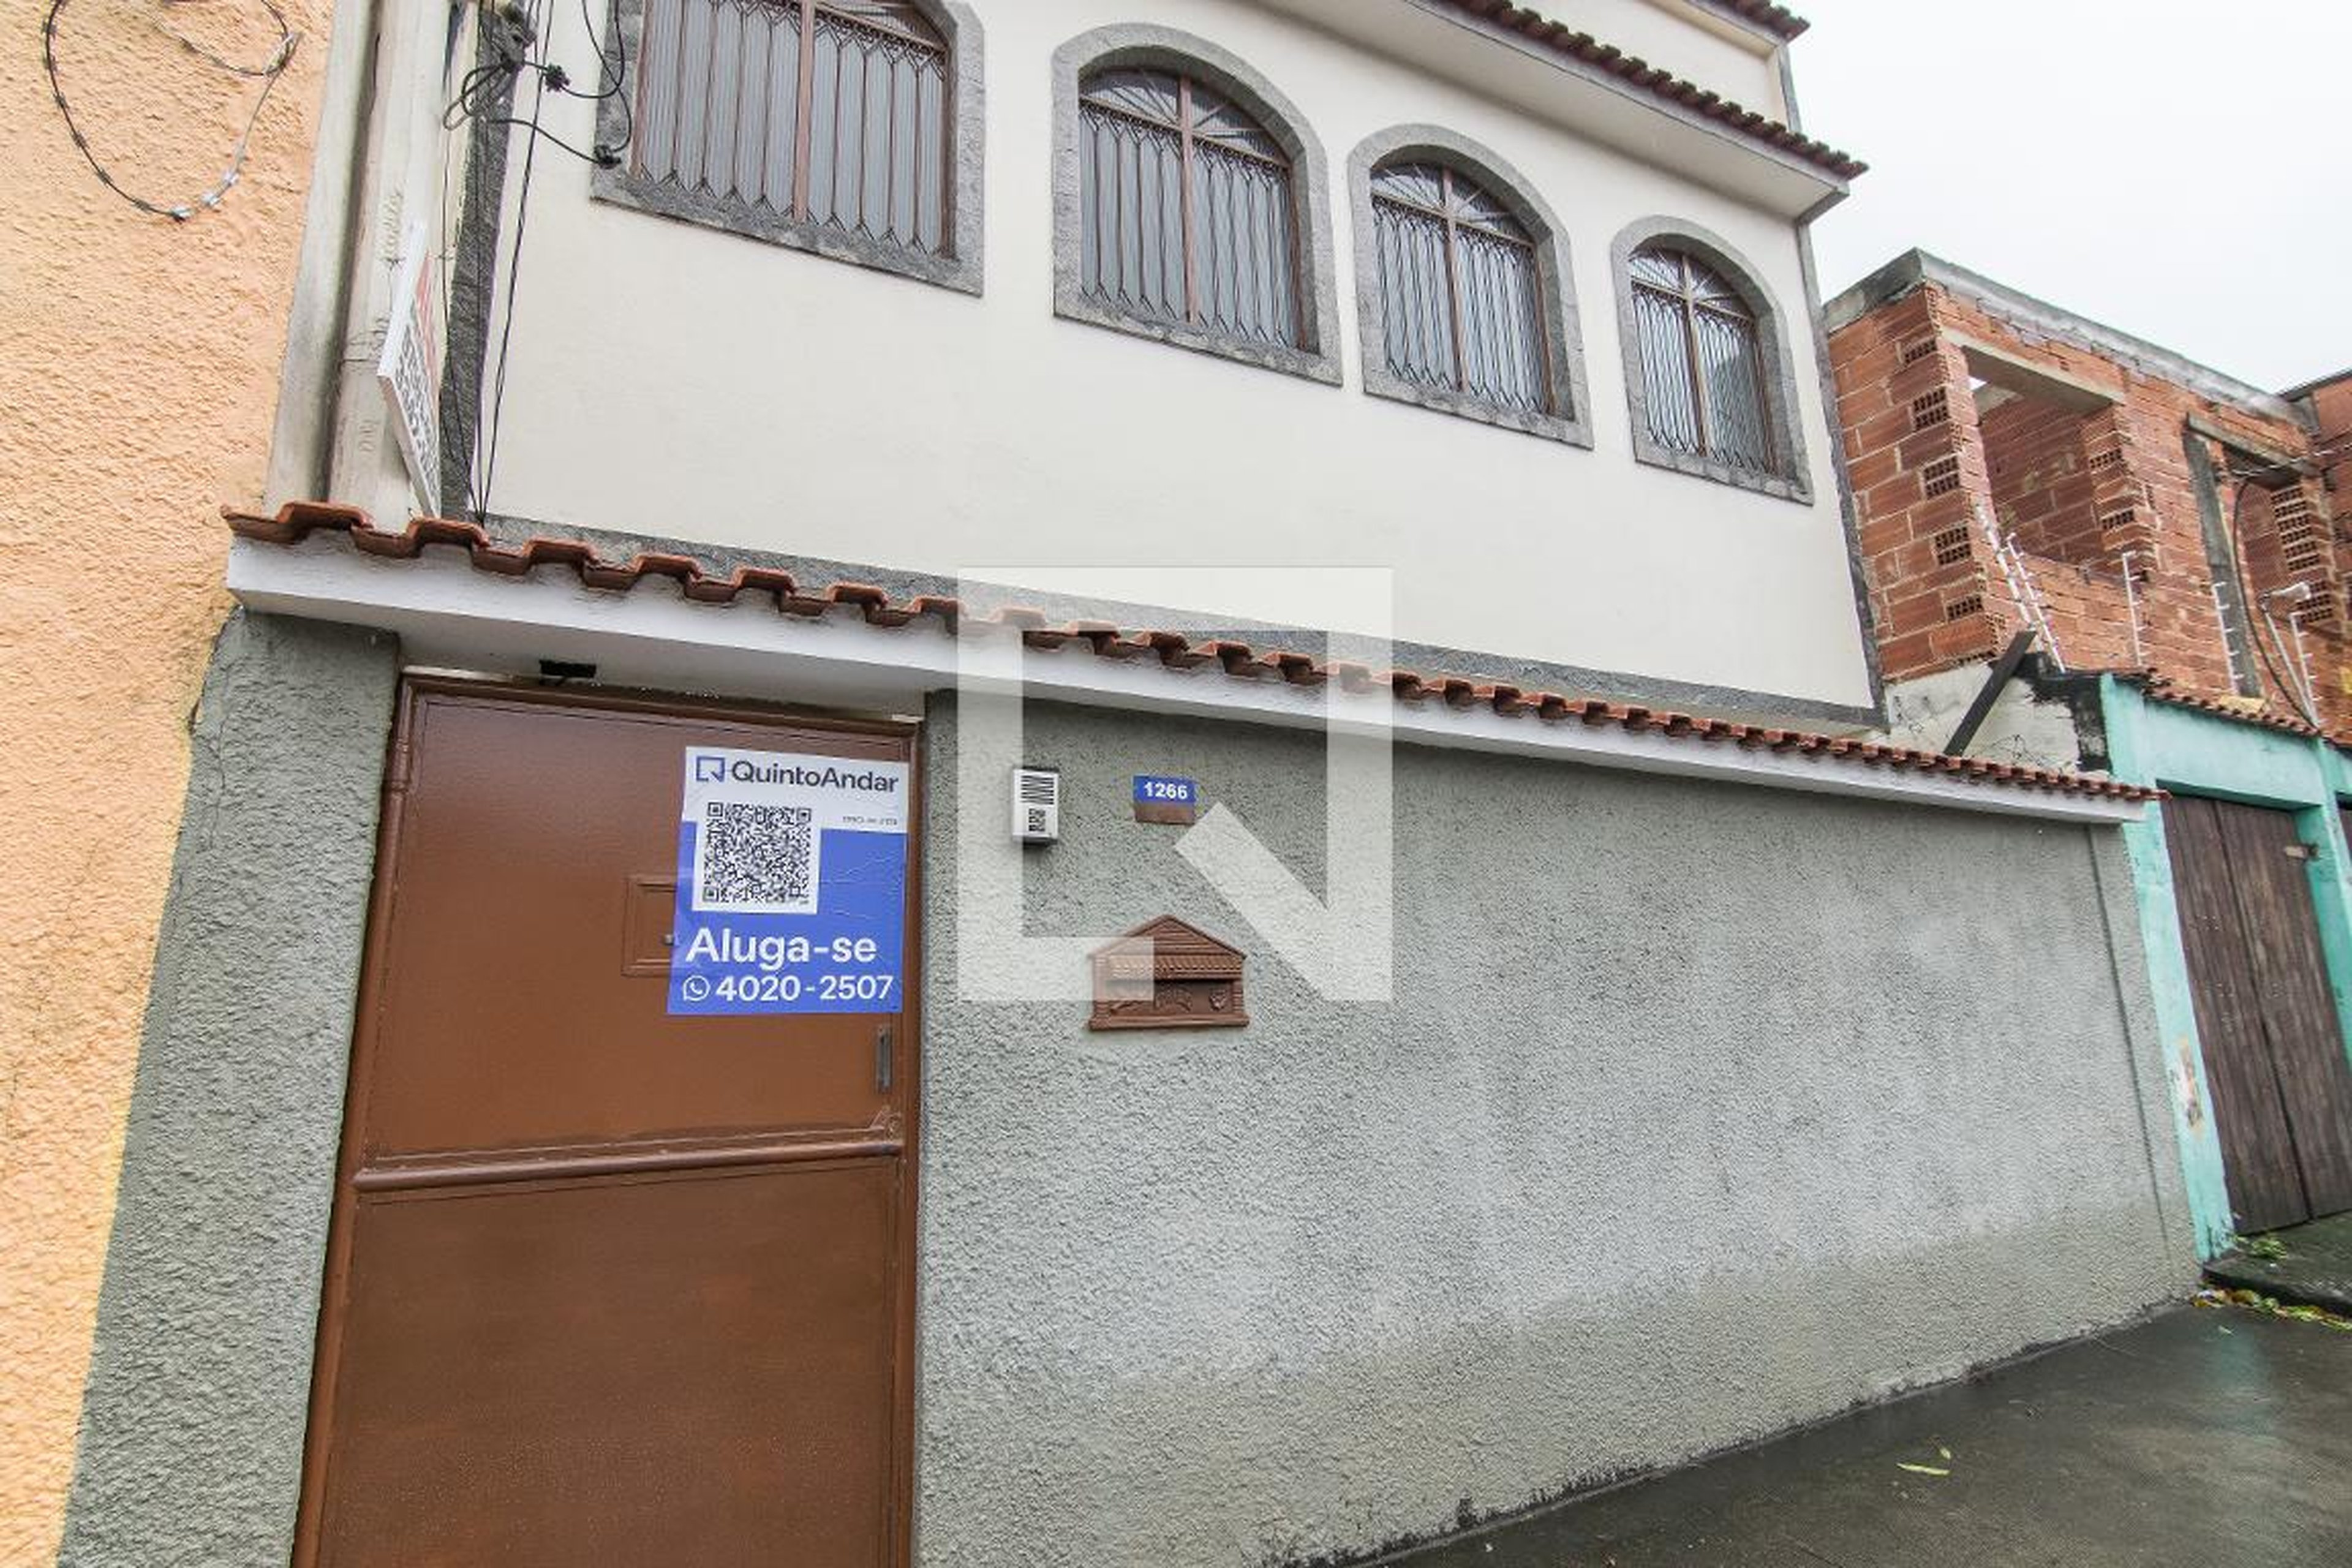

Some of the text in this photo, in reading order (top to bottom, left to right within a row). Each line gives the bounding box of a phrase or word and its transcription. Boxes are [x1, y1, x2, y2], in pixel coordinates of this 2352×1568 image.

[731, 760, 899, 793] QuintoAndar
[1144, 782, 1188, 799] 1266
[685, 927, 877, 971] Aluga-se
